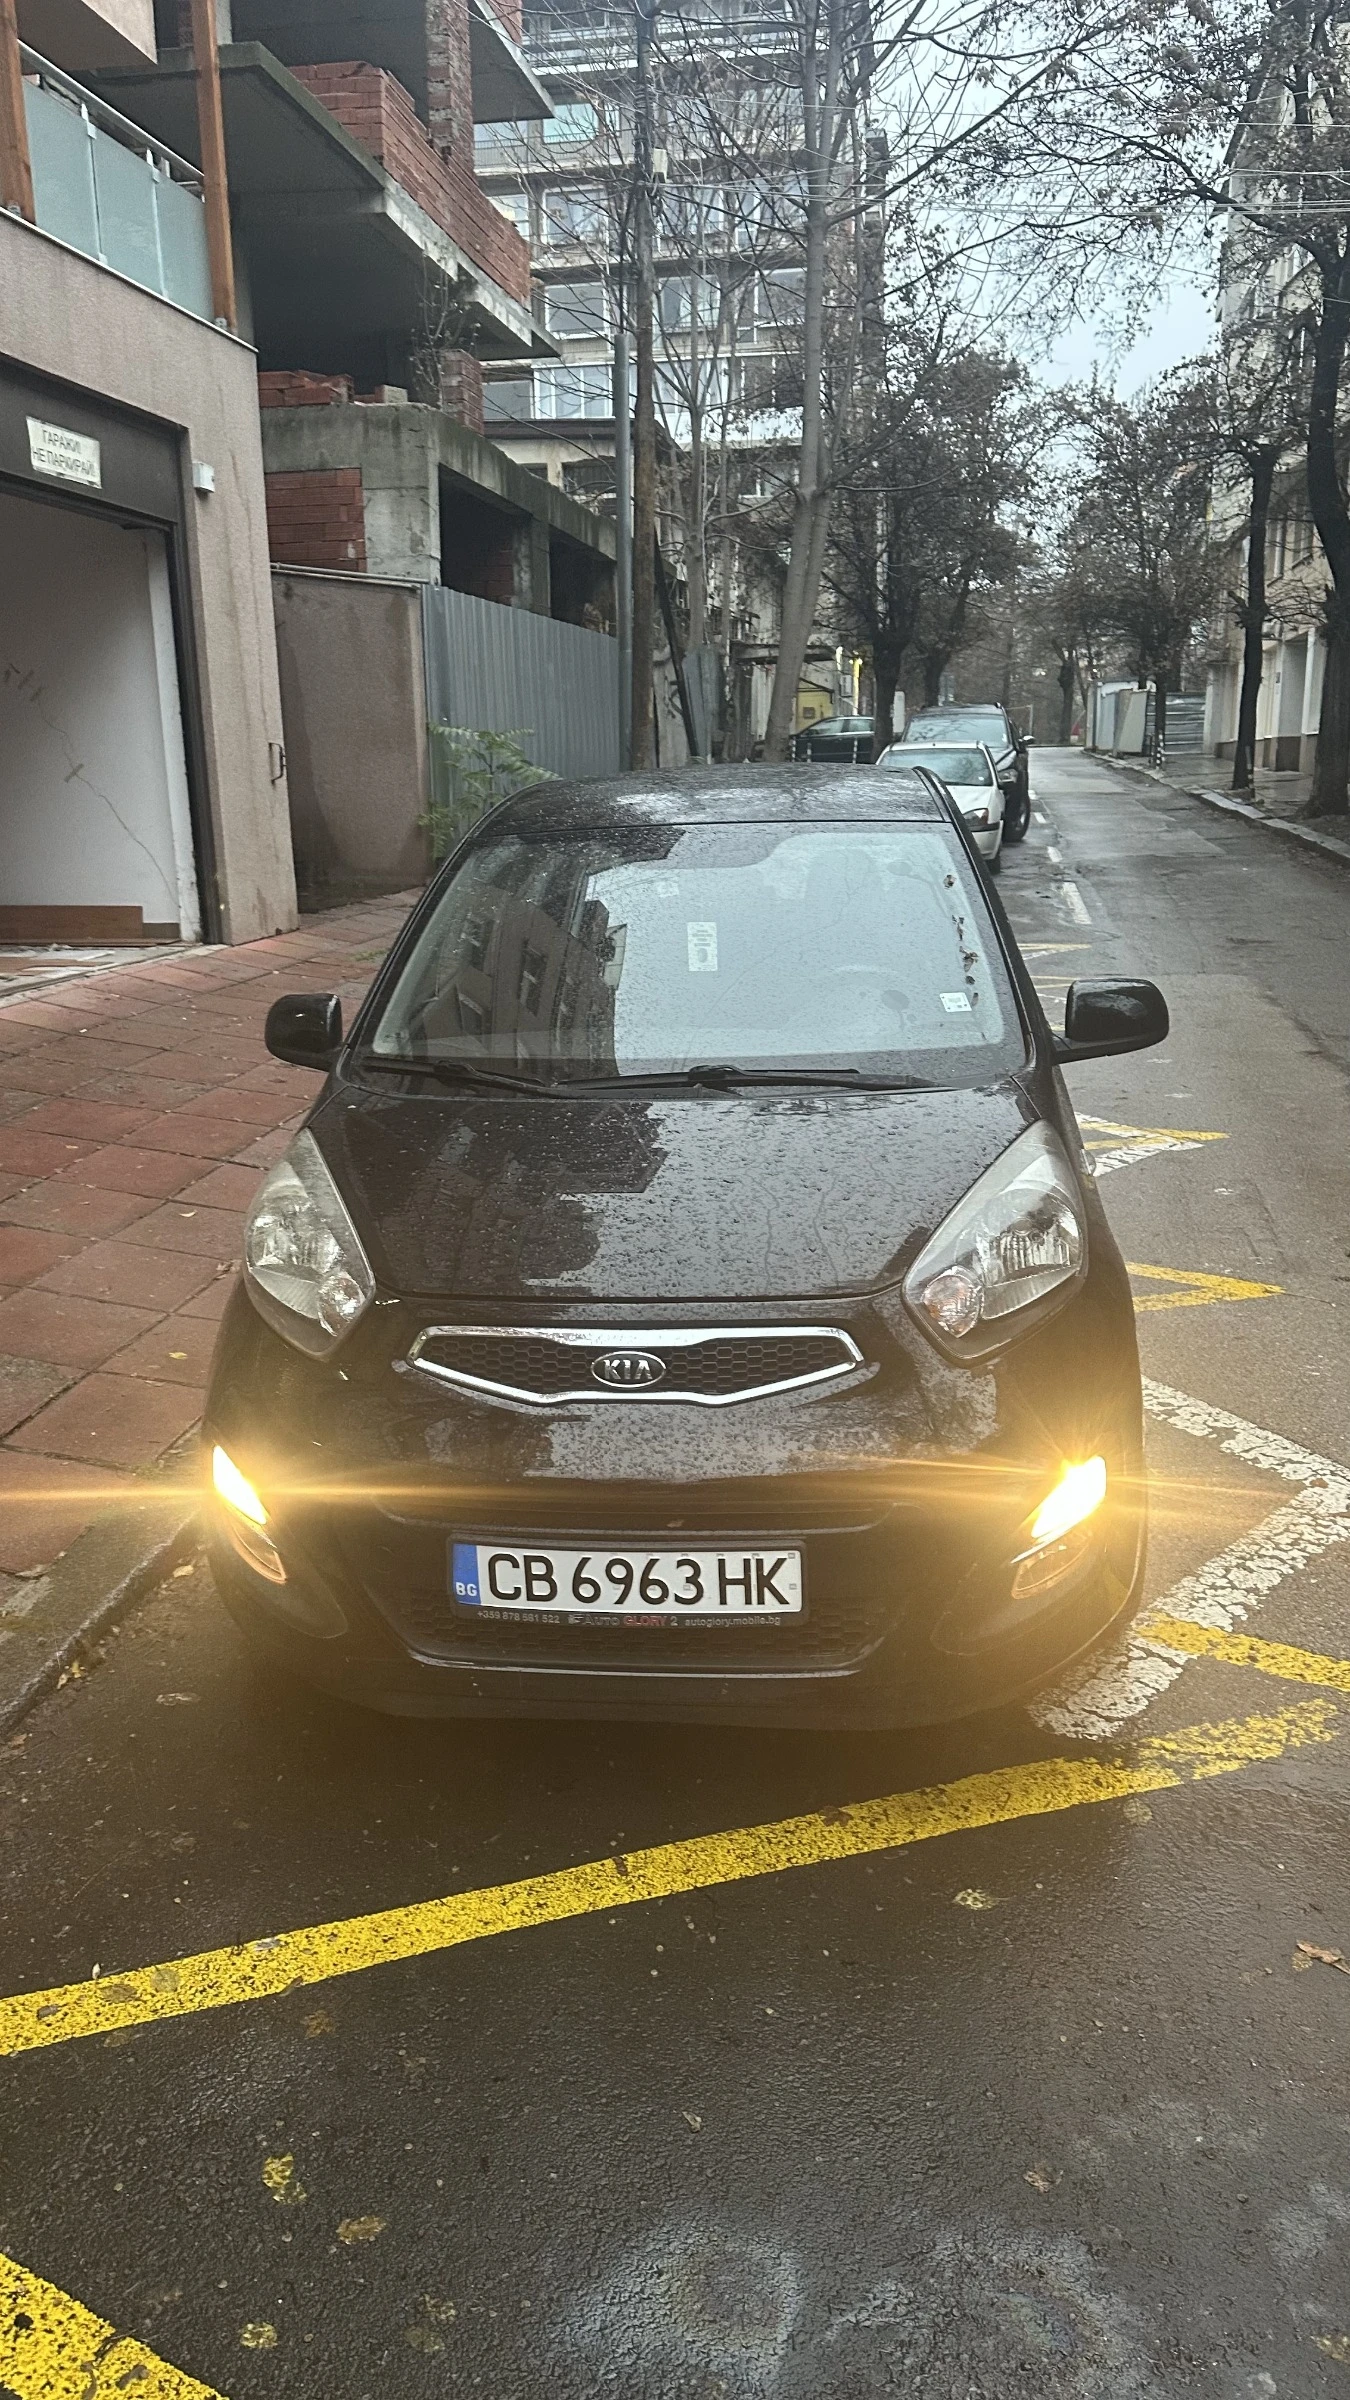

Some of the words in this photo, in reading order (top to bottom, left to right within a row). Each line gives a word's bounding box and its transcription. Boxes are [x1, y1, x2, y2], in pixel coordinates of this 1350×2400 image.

[603, 1359, 653, 1380] KIA
[455, 1581, 478, 1597] BG
[572, 1557, 704, 1605] 6963
[477, 1610, 500, 1619] +359
[502, 1611, 520, 1621] 878
[541, 1614, 560, 1624] 522
[623, 1615, 667, 1627] GLORY
[670, 1615, 679, 1626] 2
[685, 1615, 781, 1628] autoglory.mobile.bg
